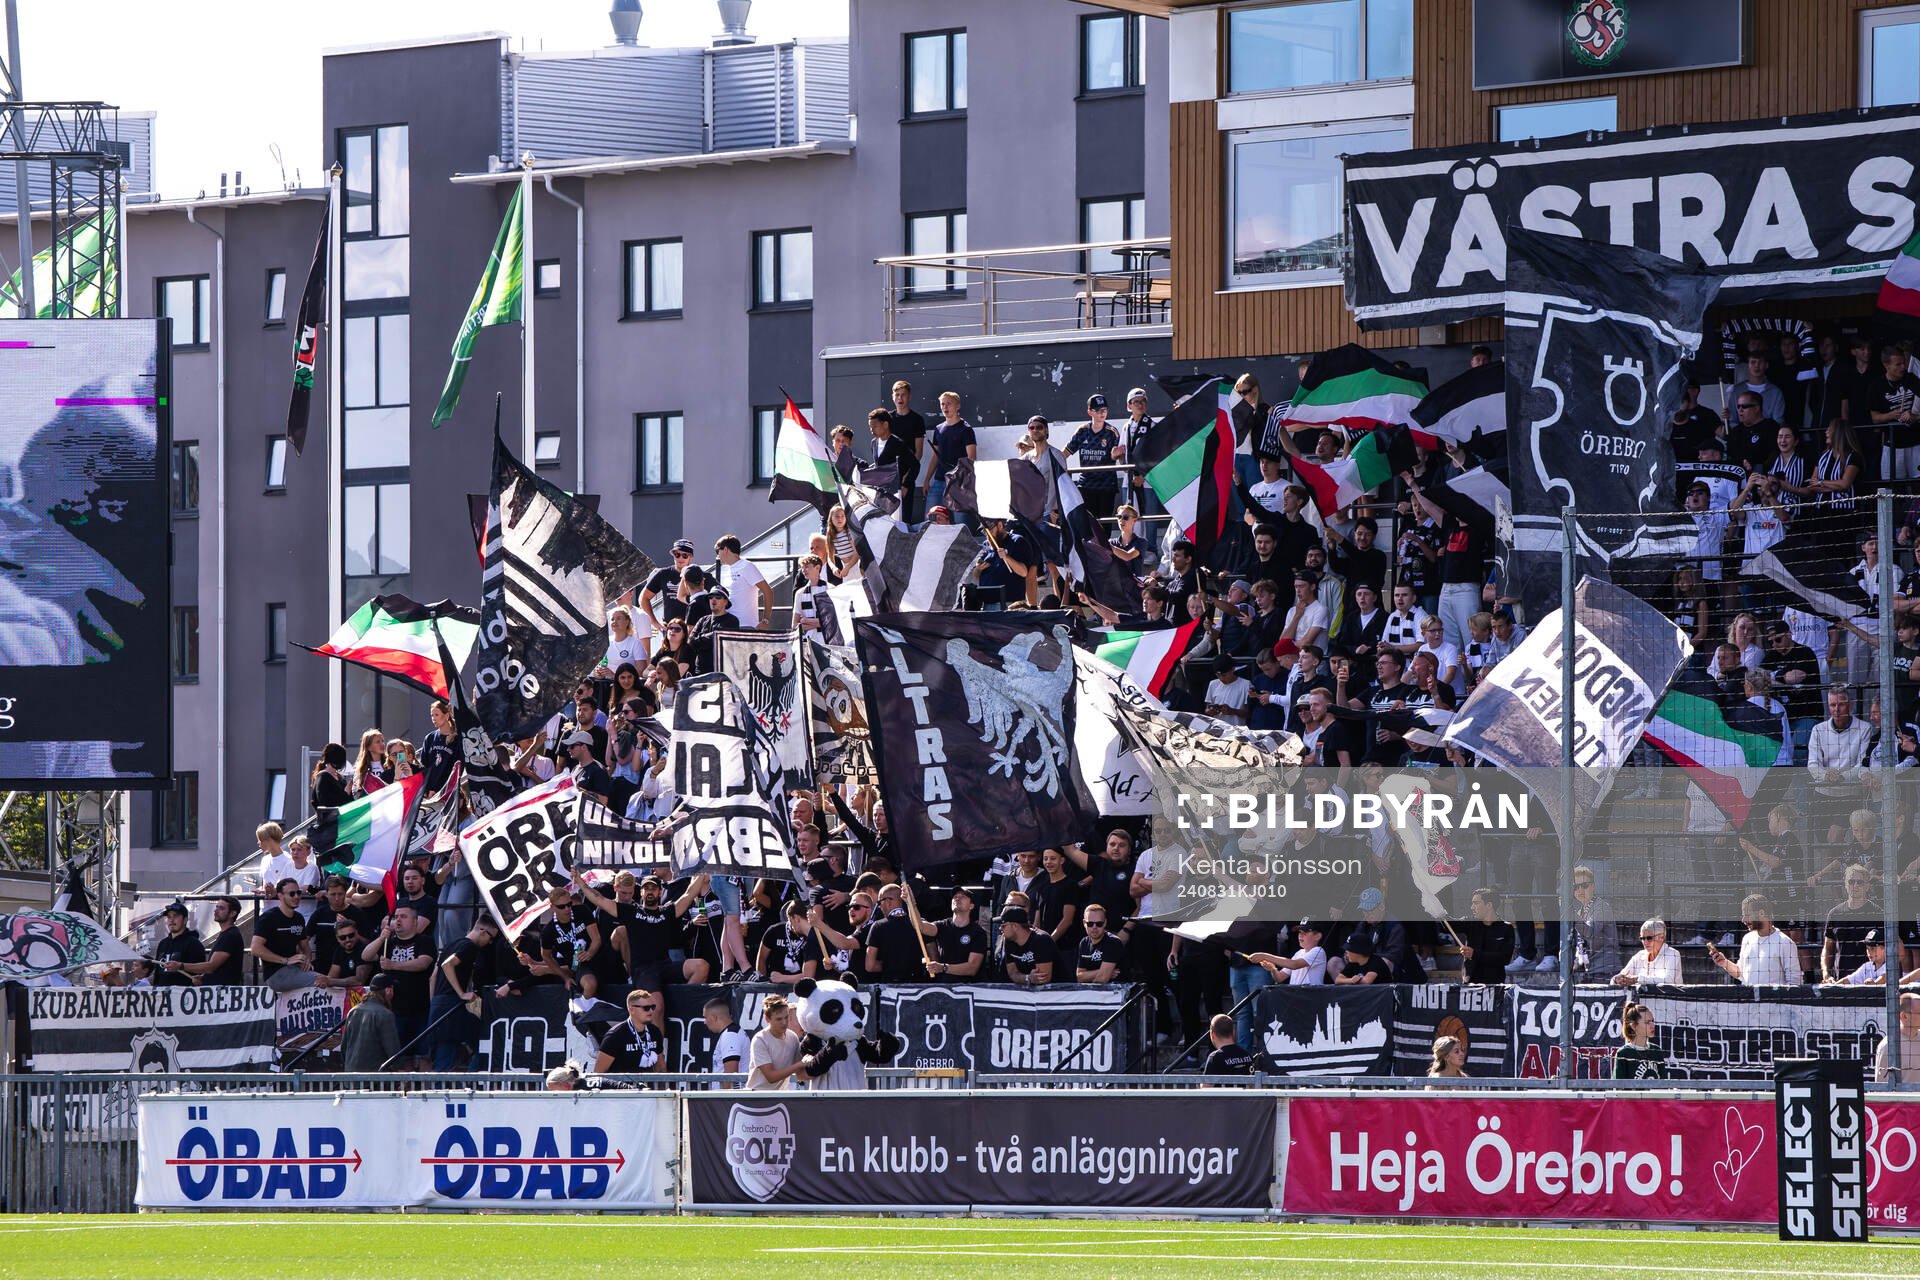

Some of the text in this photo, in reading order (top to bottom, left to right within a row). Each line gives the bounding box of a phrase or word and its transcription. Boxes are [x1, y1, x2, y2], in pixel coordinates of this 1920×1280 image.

[30, 990, 173, 1019] KUBANERNA
[1411, 984, 1494, 1012] MOT DEN
[1520, 1001, 1622, 1040] 100%
[915, 1057, 954, 1069] ÖREBRO
[990, 1018, 1113, 1072] ÖREBRO
[176, 1106, 347, 1201] ÖBAB
[434, 1103, 610, 1200] ÖBAB
[728, 1137, 794, 1165] GOLF
[820, 1137, 855, 1173] En
[864, 1135, 949, 1174] klubb
[975, 1135, 1023, 1175] två
[1031, 1135, 1239, 1185] anläggningar
[1330, 1131, 1446, 1211] Heja
[1784, 1083, 1815, 1237] SELECT
[1830, 1083, 1862, 1238] SELECT
[1884, 1203, 1907, 1223] dig
